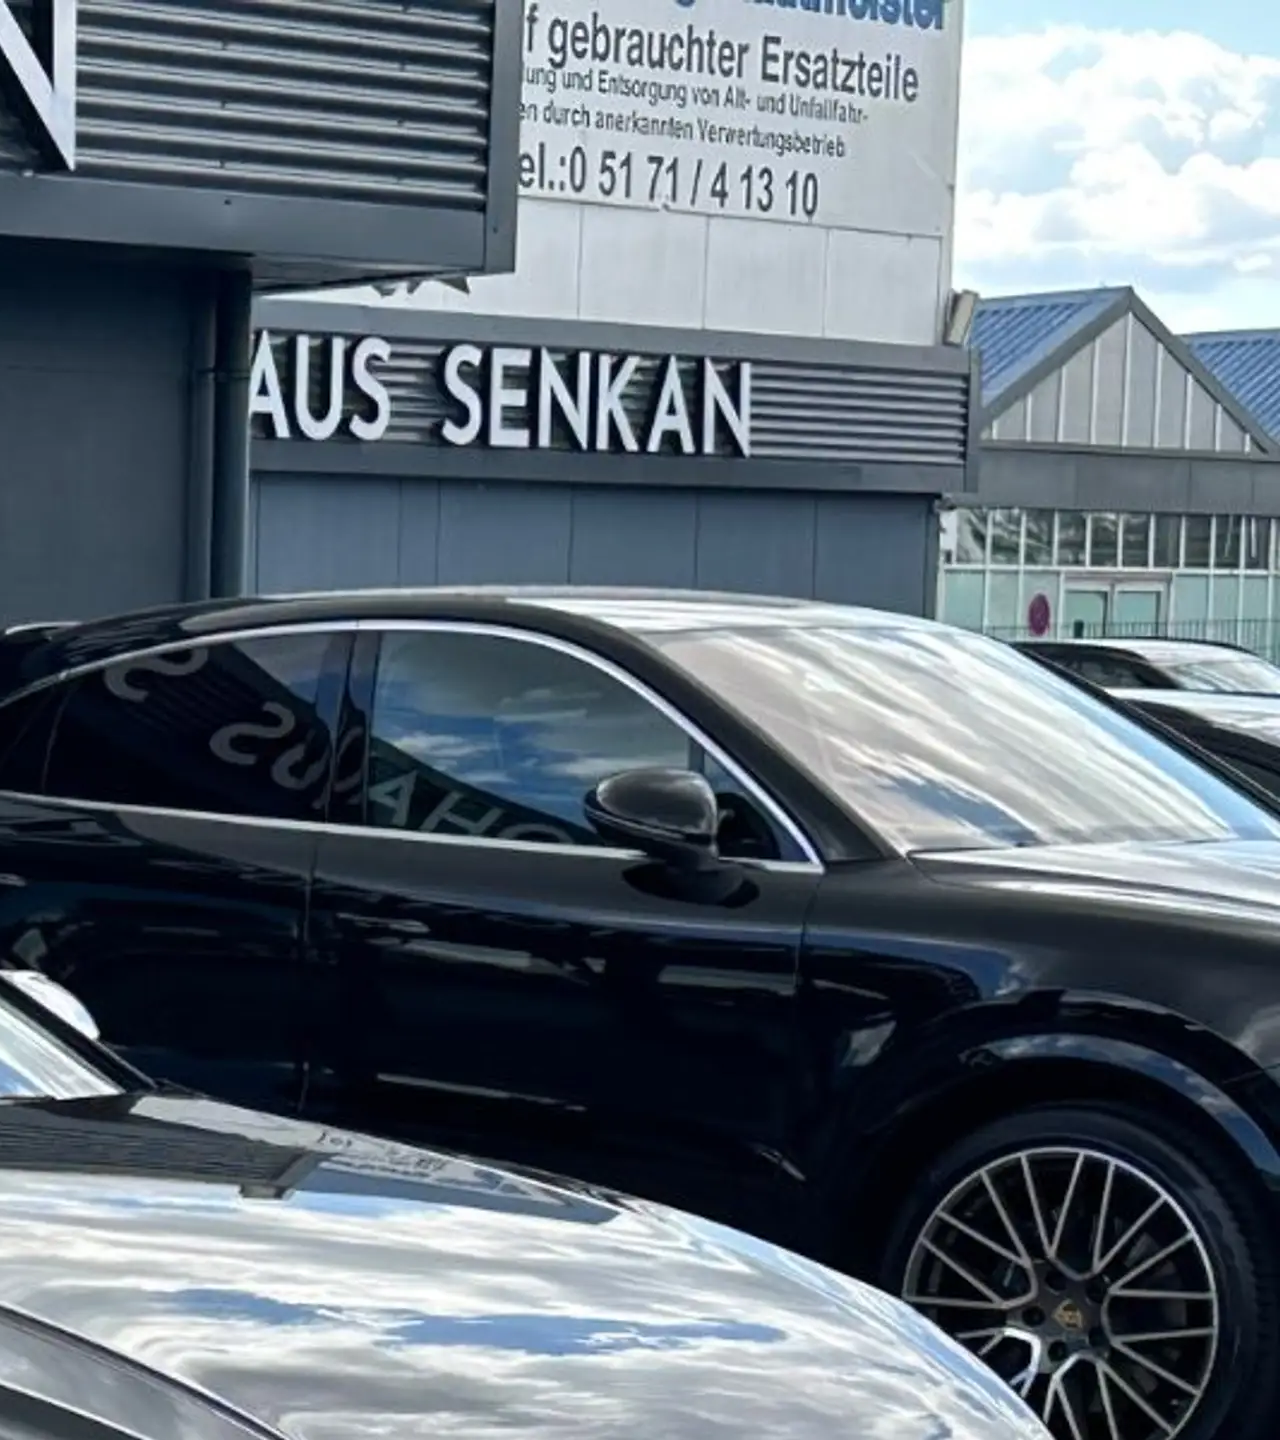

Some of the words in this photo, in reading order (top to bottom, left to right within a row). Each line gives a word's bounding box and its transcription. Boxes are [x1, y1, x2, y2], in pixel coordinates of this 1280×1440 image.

[548, 12, 750, 78] gebrauchter
[762, 34, 919, 101] Ersatzteile
[543, 100, 590, 127] durch
[595, 109, 693, 140] anerkannten
[697, 116, 845, 157] Verwertungsbetrieb
[562, 68, 593, 91] und
[598, 69, 687, 108] Entsorgung
[692, 87, 720, 107] von
[757, 92, 786, 115] und
[789, 93, 868, 124] Unfallfahr-
[599, 151, 632, 199] 51
[647, 156, 679, 203] 71
[711, 161, 728, 208] 4
[740, 165, 773, 212] 13
[785, 170, 819, 216] 10
[442, 343, 752, 457] SENKAN
